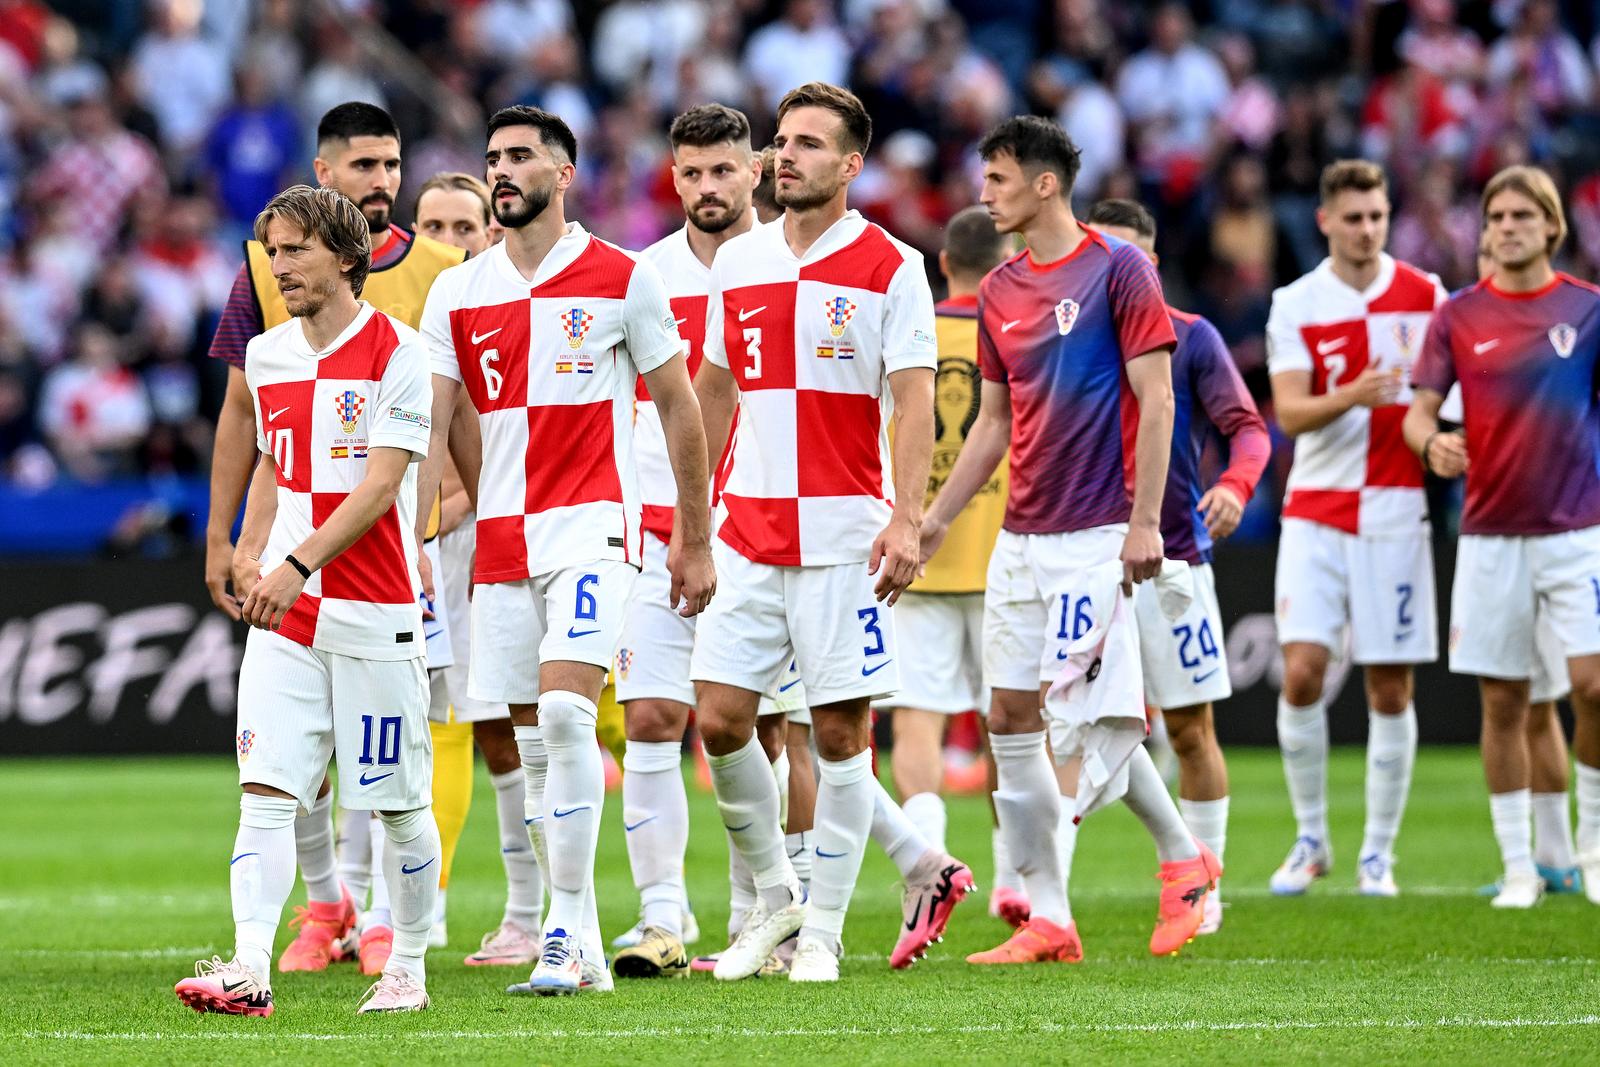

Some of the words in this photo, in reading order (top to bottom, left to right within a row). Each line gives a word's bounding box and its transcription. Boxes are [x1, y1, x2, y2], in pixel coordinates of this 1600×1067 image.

[480, 348, 504, 400] 6
[743, 327, 762, 379] 3
[575, 574, 598, 621] 6
[1057, 593, 1093, 640] 16
[1396, 583, 1413, 625] 2
[857, 606, 885, 657] 3
[1172, 617, 1219, 670] 24
[359, 714, 403, 766] 10
